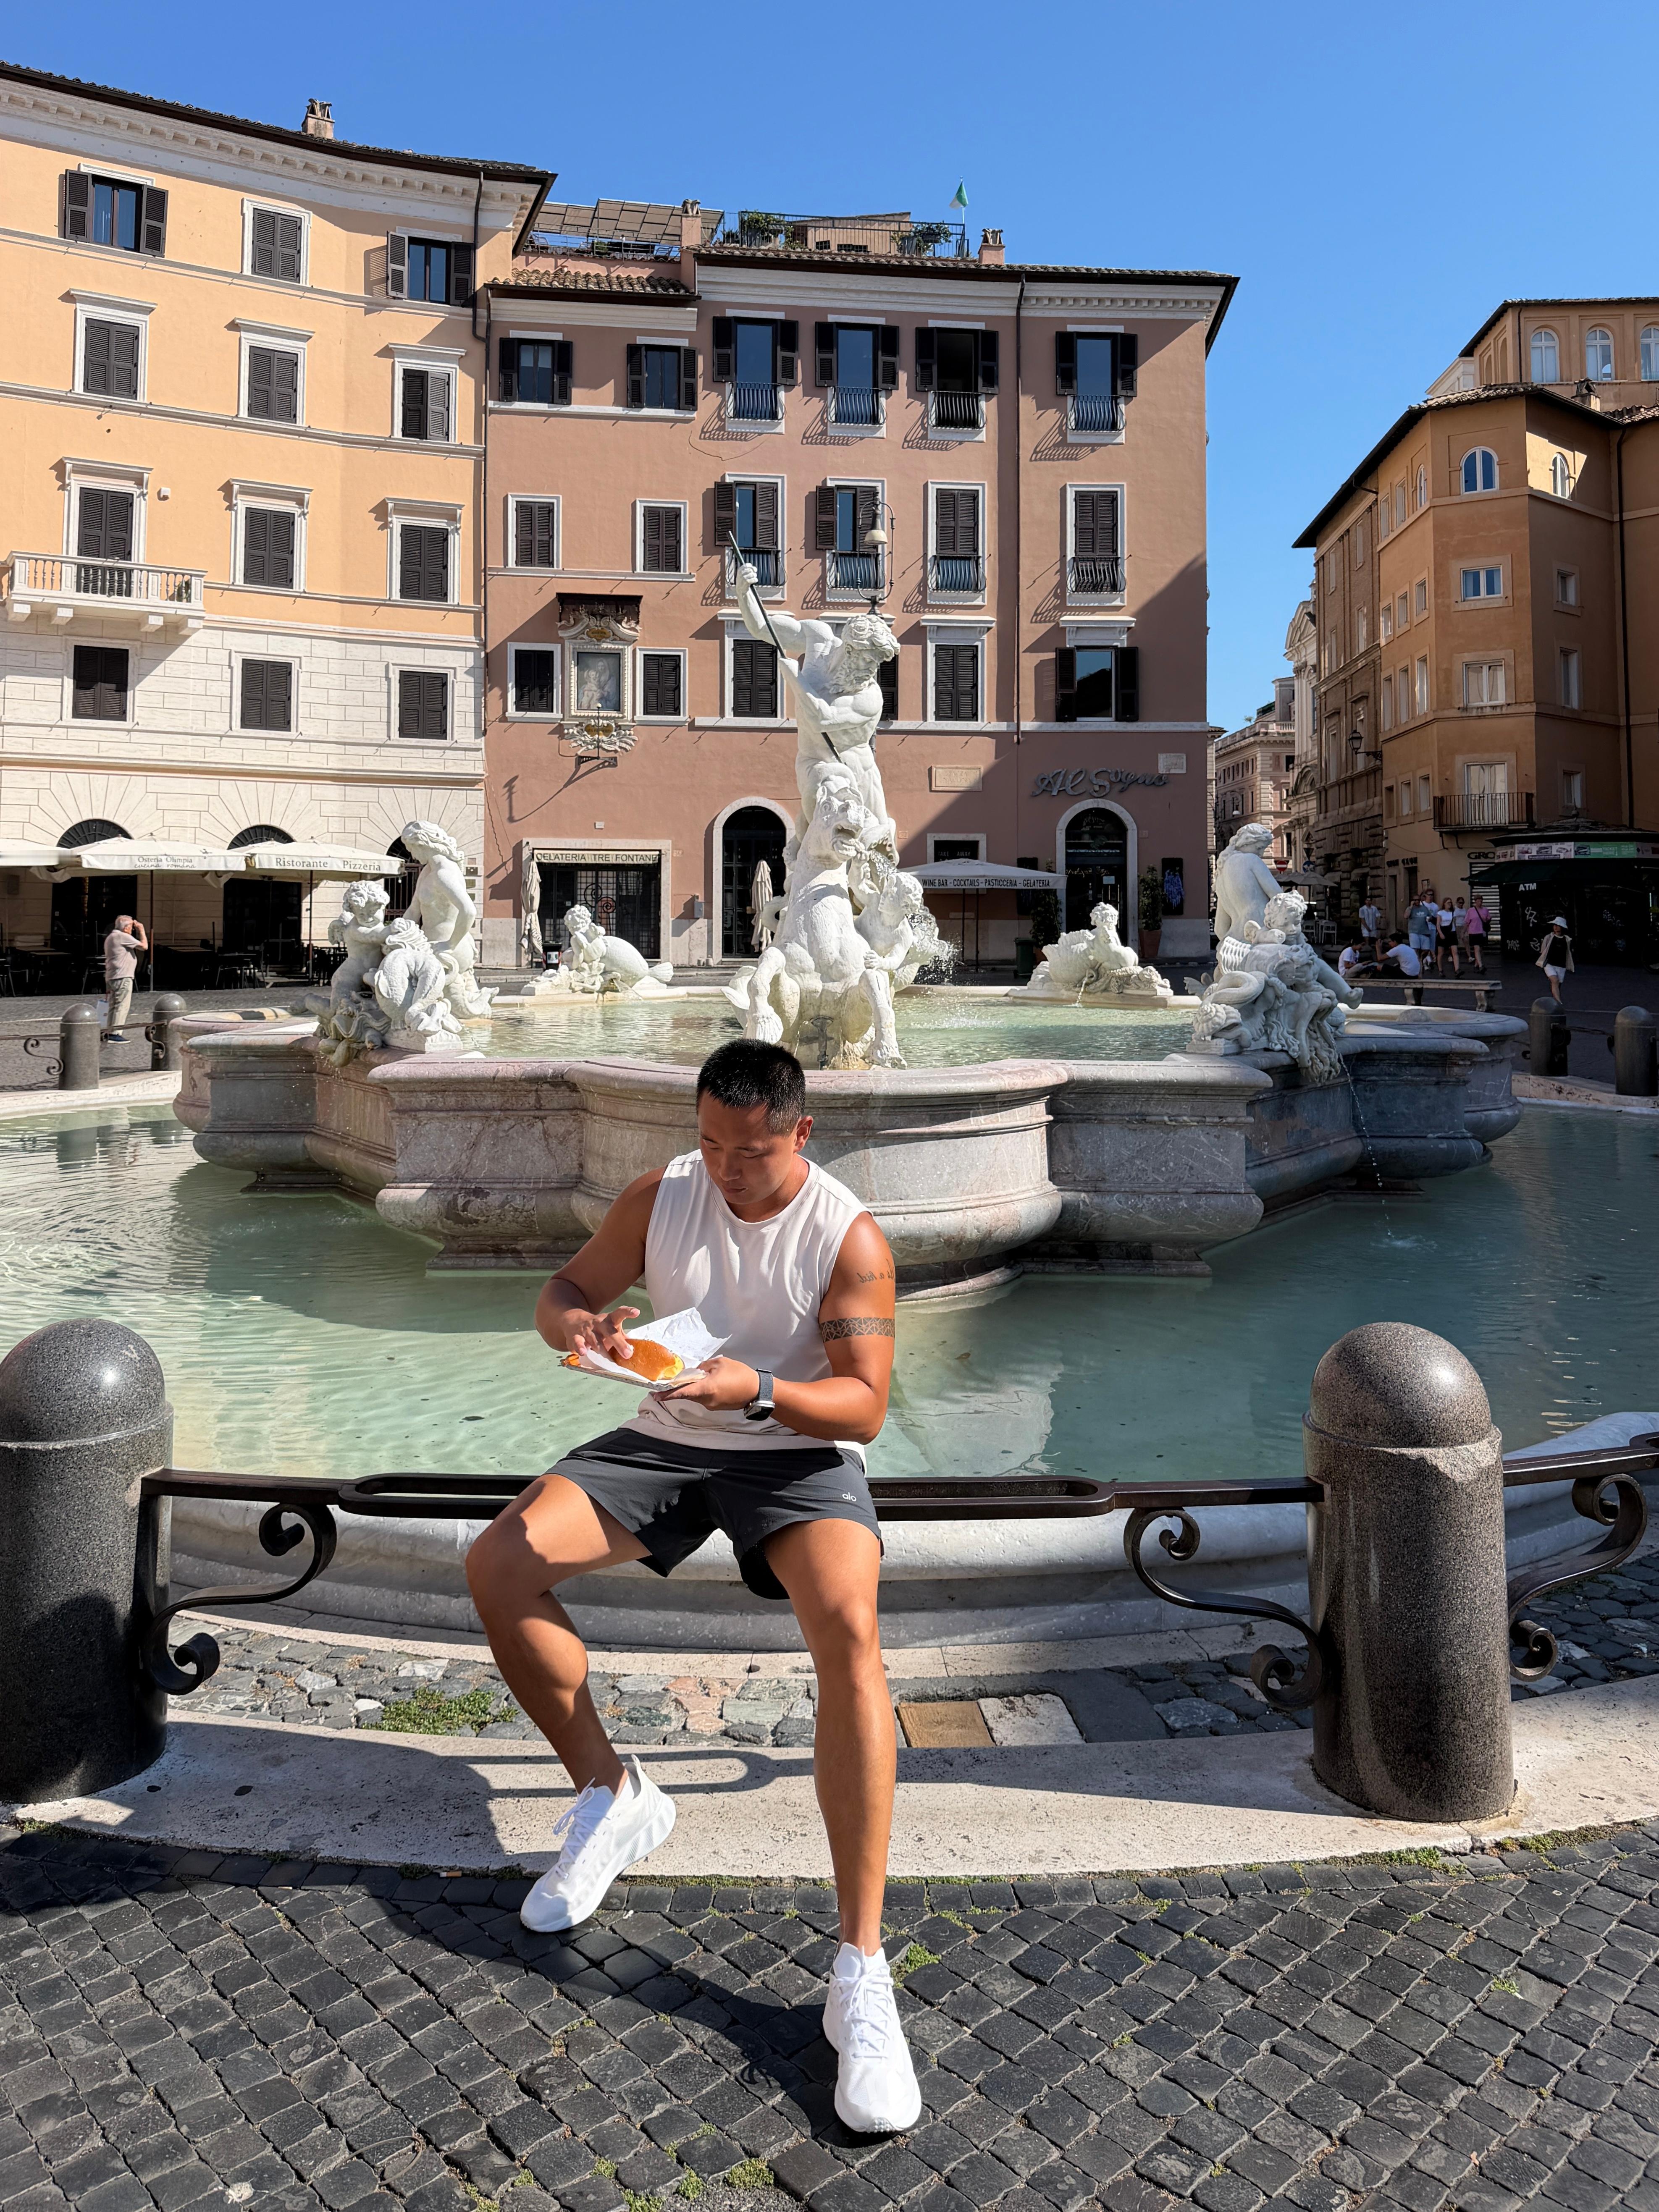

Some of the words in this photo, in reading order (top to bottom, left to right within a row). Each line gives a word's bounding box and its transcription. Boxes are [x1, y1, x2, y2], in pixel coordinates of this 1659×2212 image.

[1030, 768, 1087, 797] Al
[1089, 767, 1170, 798] Sogno
[536, 853, 586, 861] GELATERIA
[276, 857, 328, 868] Ristorante
[343, 860, 381, 871] Pizzeria
[922, 879, 936, 887] WINE
[938, 879, 948, 887] BAR
[984, 879, 1017, 887] PASTICCERIA
[1518, 883, 1537, 892] ATM
[842, 1492, 857, 1502] alo
